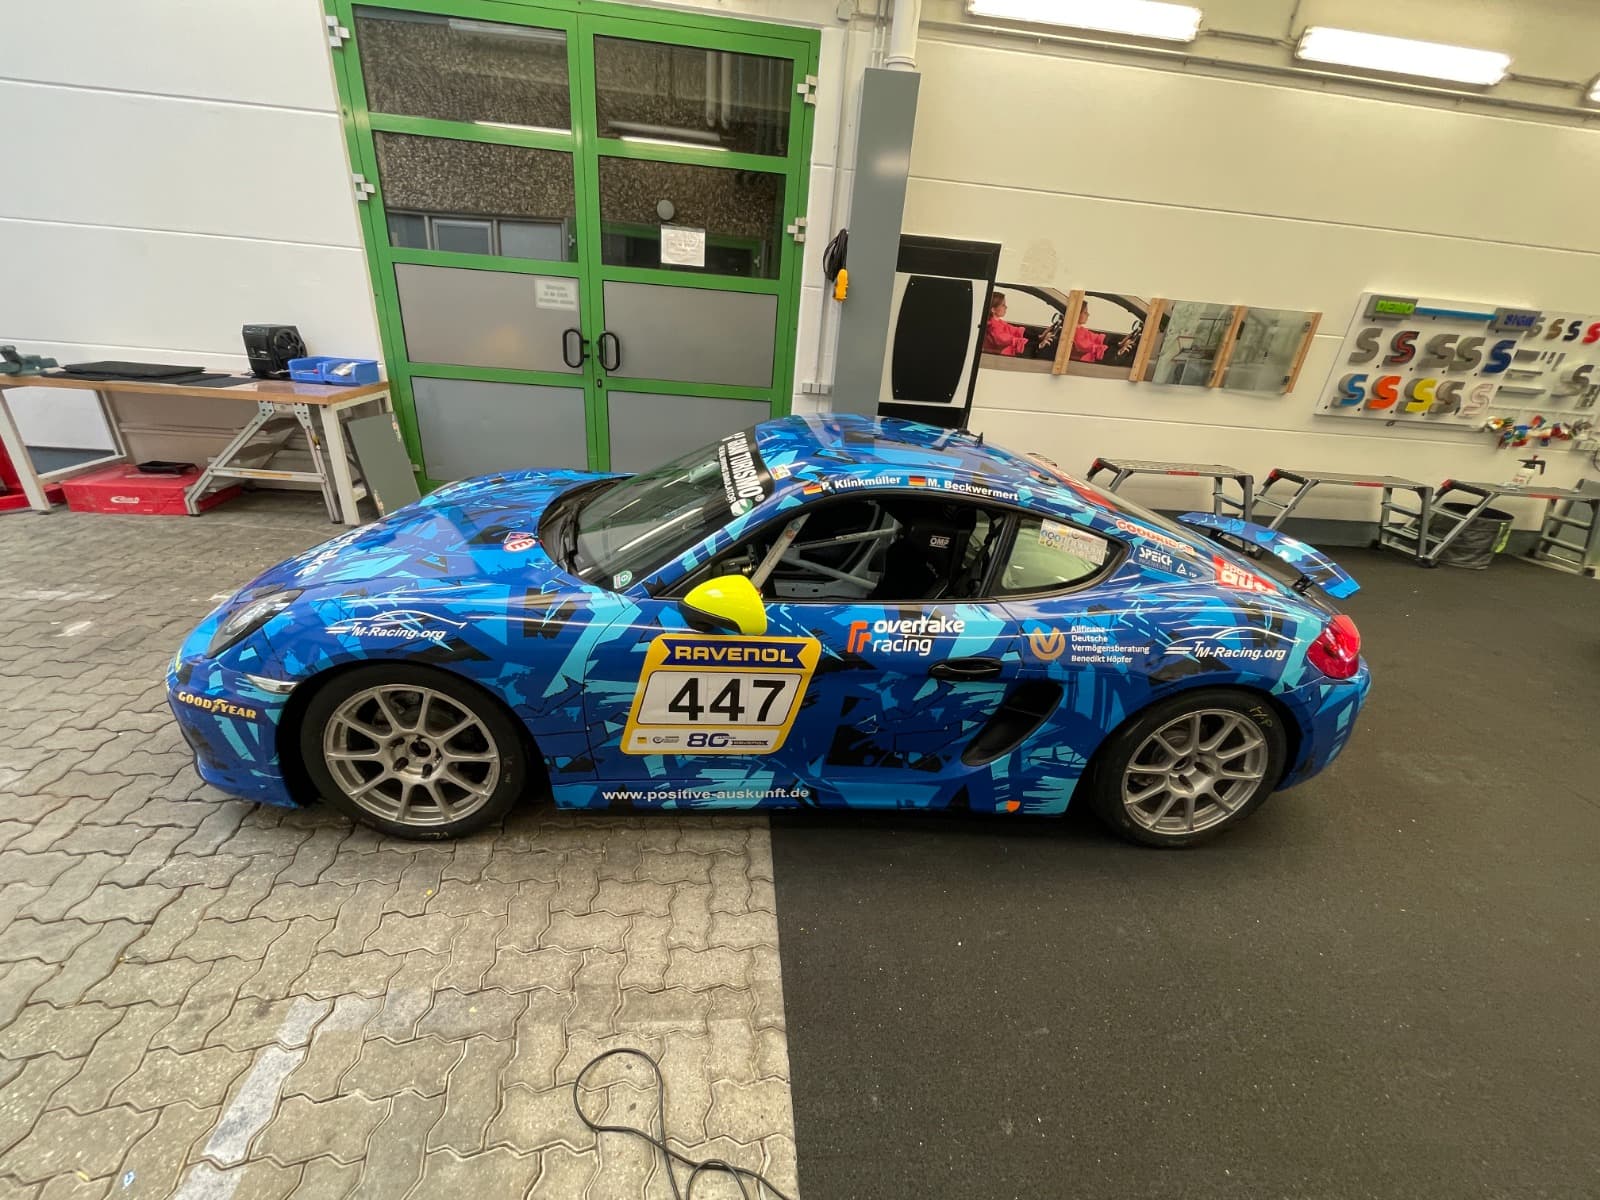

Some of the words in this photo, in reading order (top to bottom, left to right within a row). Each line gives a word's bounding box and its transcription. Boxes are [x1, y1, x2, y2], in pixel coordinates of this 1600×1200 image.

[835, 476, 901, 489] Klinkmüller
[927, 478, 940, 488] M.
[943, 479, 1019, 501] Beckwermert
[351, 622, 447, 640] TM-Racing.org
[873, 615, 966, 634] overtake
[872, 635, 933, 656] racing
[1071, 634, 1109, 643] Deutsche
[674, 645, 794, 663] RAVENOL
[1071, 644, 1151, 655] Vermögensberatung
[1194, 640, 1287, 660] TM-Racing.org
[1071, 655, 1106, 663] Benedikt
[1106, 656, 1133, 664] Höpfer
[668, 677, 787, 722] 447
[601, 787, 810, 802] www.positive-auskunft.de
